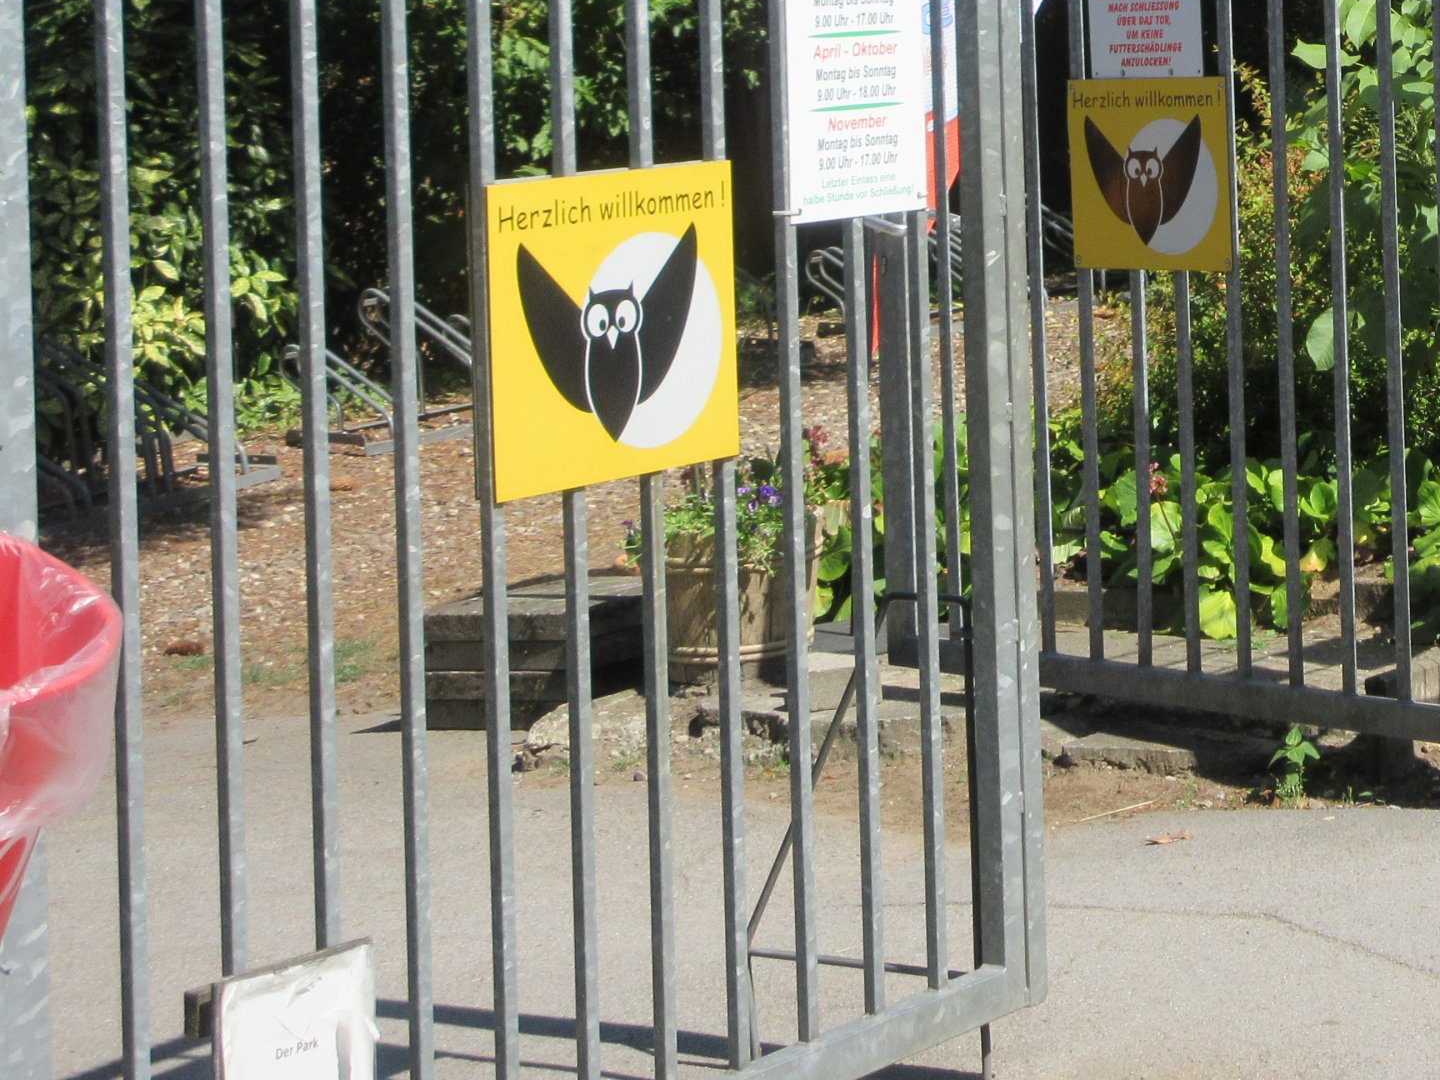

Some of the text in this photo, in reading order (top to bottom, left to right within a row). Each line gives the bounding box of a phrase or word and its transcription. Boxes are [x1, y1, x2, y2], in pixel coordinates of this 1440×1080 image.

[1108, 1, 1180, 13] NACH SCHLIESSUNG
[815, 14, 832, 28] 9.00
[834, 14, 849, 27] Uhr
[856, 12, 877, 26] 17.00
[880, 11, 894, 25] Uhr
[1116, 14, 1137, 26] ÜBER
[1138, 15, 1153, 25] DAS
[1126, 29, 1164, 40] UM KEINE
[813, 43, 841, 62] April
[852, 41, 898, 57] Oktober
[1109, 41, 1183, 54] FUTTERSCHÄDLINGE
[1120, 56, 1172, 68] ANZULOCKEN!
[816, 65, 897, 83] Montag bis Sonntag
[817, 88, 834, 102] 9.00
[836, 87, 851, 100] Uhr
[859, 84, 880, 98] 18.00
[881, 83, 896, 97] Uhr
[1072, 90, 1131, 108] Herzlich
[1134, 90, 1213, 107] willkommen
[828, 114, 887, 132] November
[817, 133, 898, 153] Montag bis Sonntag
[819, 157, 835, 171] 9.00
[837, 155, 853, 169] Uhr
[860, 152, 881, 167] 17.00
[883, 151, 898, 164] Uhr
[822, 173, 896, 189] Letzter Einlass eine
[803, 194, 825, 206] halbe
[826, 191, 854, 203] Stunde
[855, 190, 868, 200] vor
[498, 196, 592, 233] Herzlich
[599, 190, 714, 221] willkommen
[275, 1036, 320, 1060] Der Park
